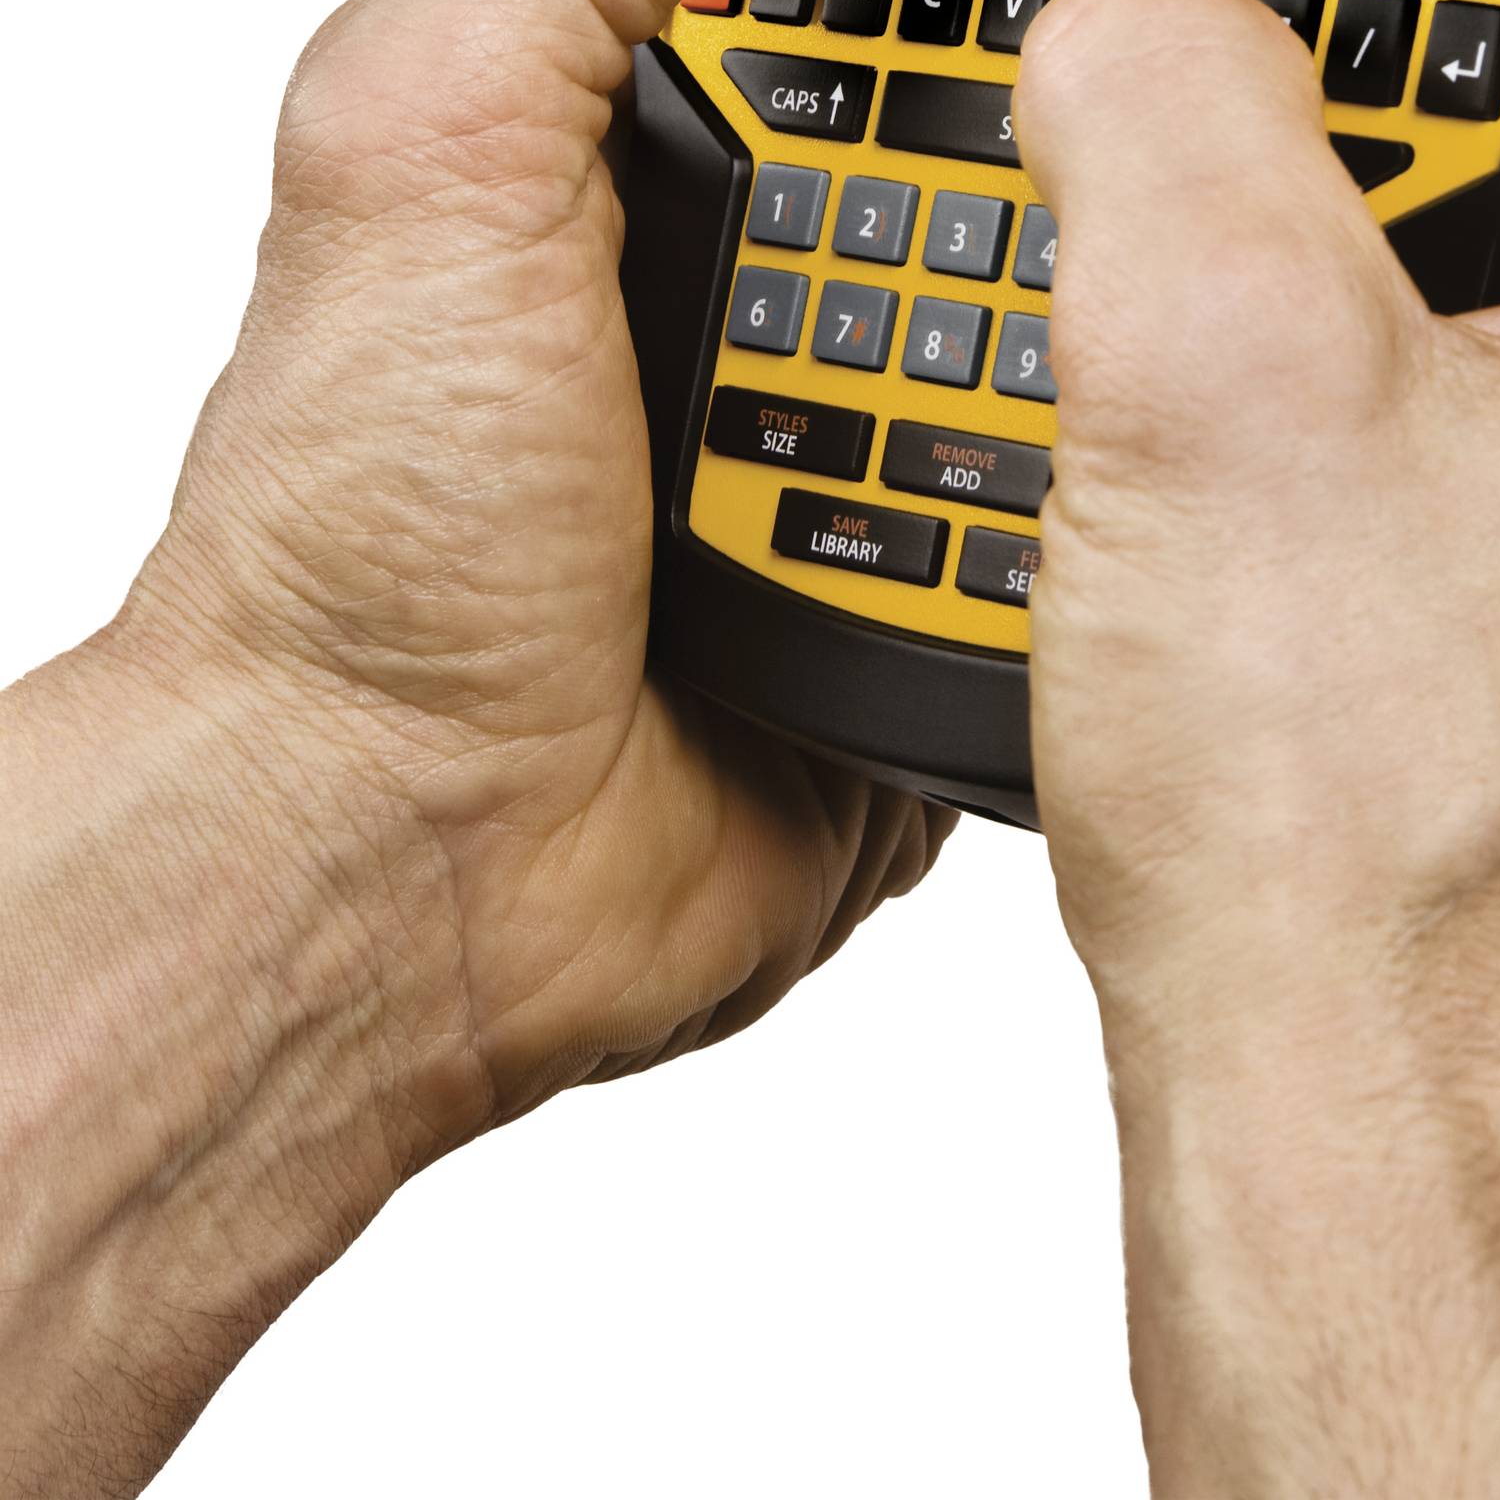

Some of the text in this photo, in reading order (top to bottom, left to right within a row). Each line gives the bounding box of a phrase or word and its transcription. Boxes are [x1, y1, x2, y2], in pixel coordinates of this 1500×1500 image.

[771, 87, 820, 115] CAPS
[772, 192, 784, 222] 1
[858, 207, 877, 238] 2
[949, 222, 967, 252] 3
[1040, 237, 1057, 268] 4
[750, 298, 767, 327] 6
[835, 313, 853, 344] 7
[924, 330, 942, 360] 8
[1019, 348, 1037, 379] 9
[758, 408, 808, 434] STYLES
[761, 430, 797, 456] SIZE
[932, 442, 997, 470] REMOVE
[940, 466, 981, 491] ADD
[831, 514, 869, 537] SAVE
[810, 531, 882, 564] LIBRARY
